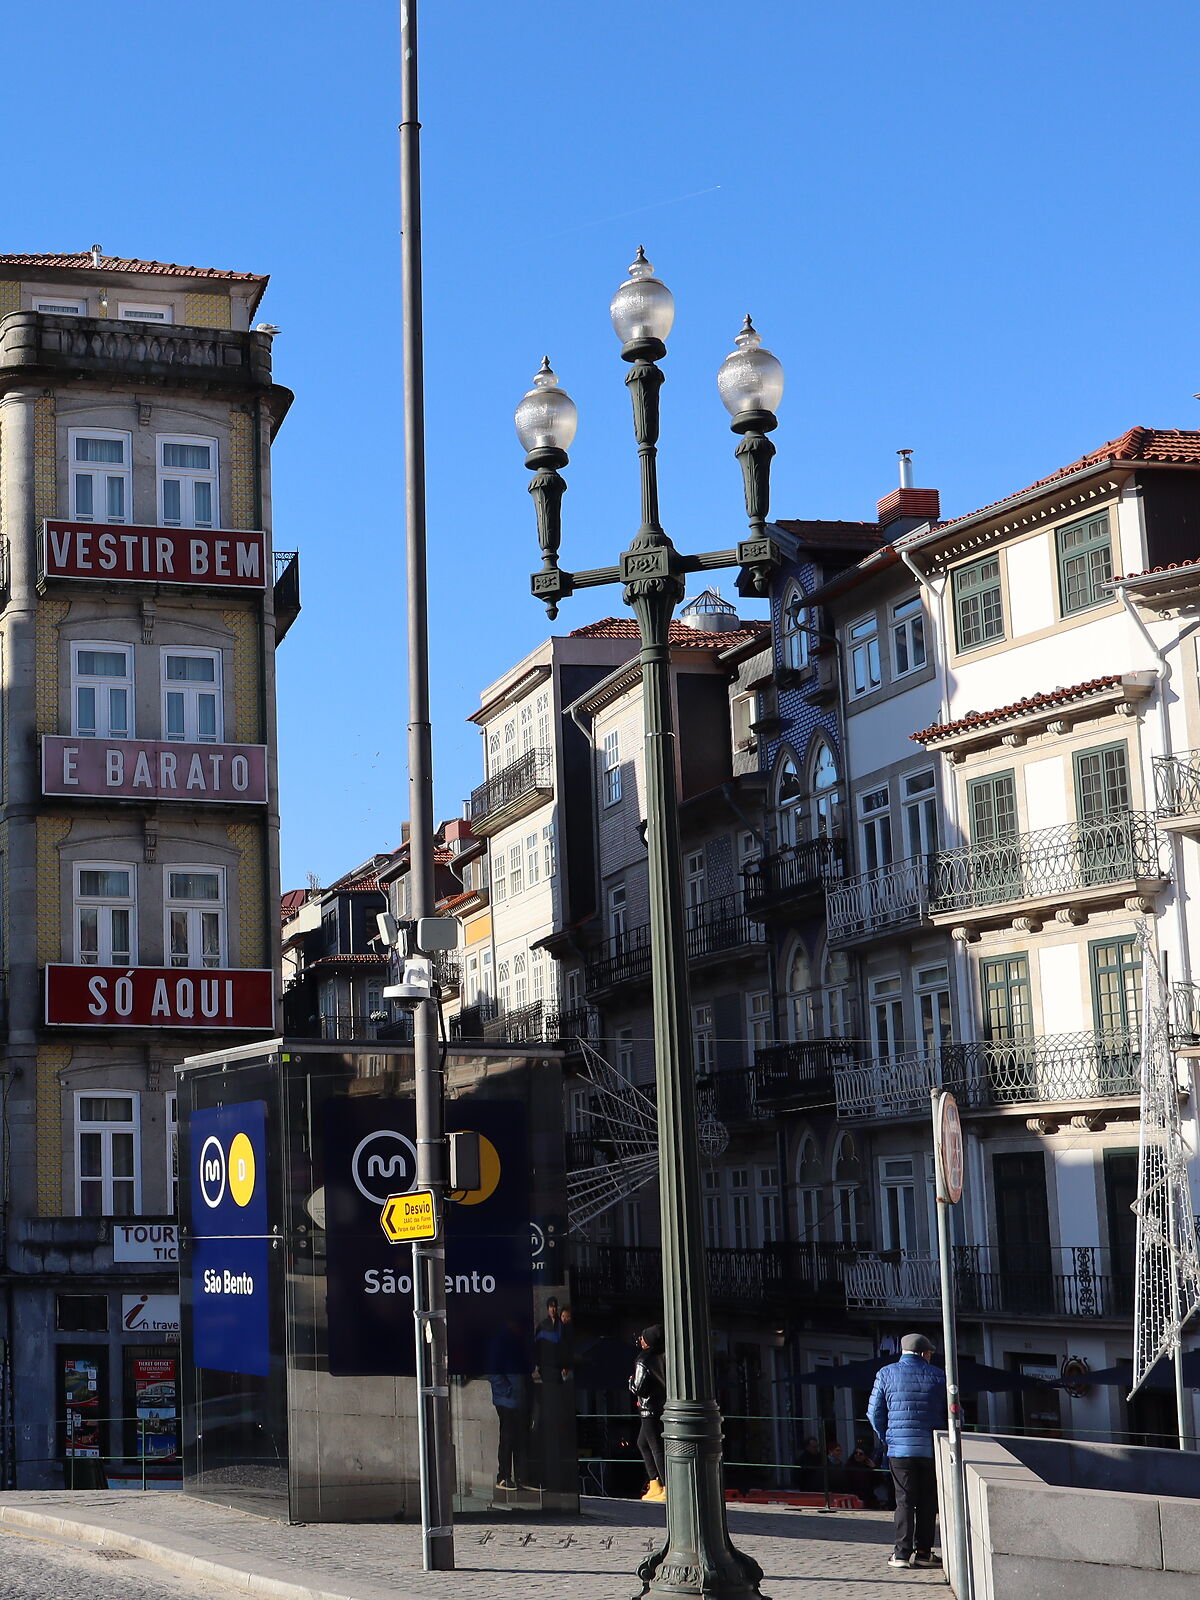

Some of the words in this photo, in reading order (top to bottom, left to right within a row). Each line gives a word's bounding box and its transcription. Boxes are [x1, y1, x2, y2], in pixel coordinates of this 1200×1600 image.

[50, 530, 175, 573] VESTIR
[190, 539, 259, 578] BEM
[63, 747, 79, 785] E
[106, 749, 249, 792] BARATO
[88, 970, 135, 1016] SÓ
[151, 978, 233, 1019] AQUI
[237, 1158, 246, 1181] D
[405, 1201, 431, 1215] Desvio
[153, 1247, 177, 1260] TIC
[203, 1268, 222, 1294] São
[223, 1269, 254, 1295] Bento
[364, 1268, 412, 1294] São
[444, 1270, 496, 1293] ento
[153, 1320, 179, 1330] trave
